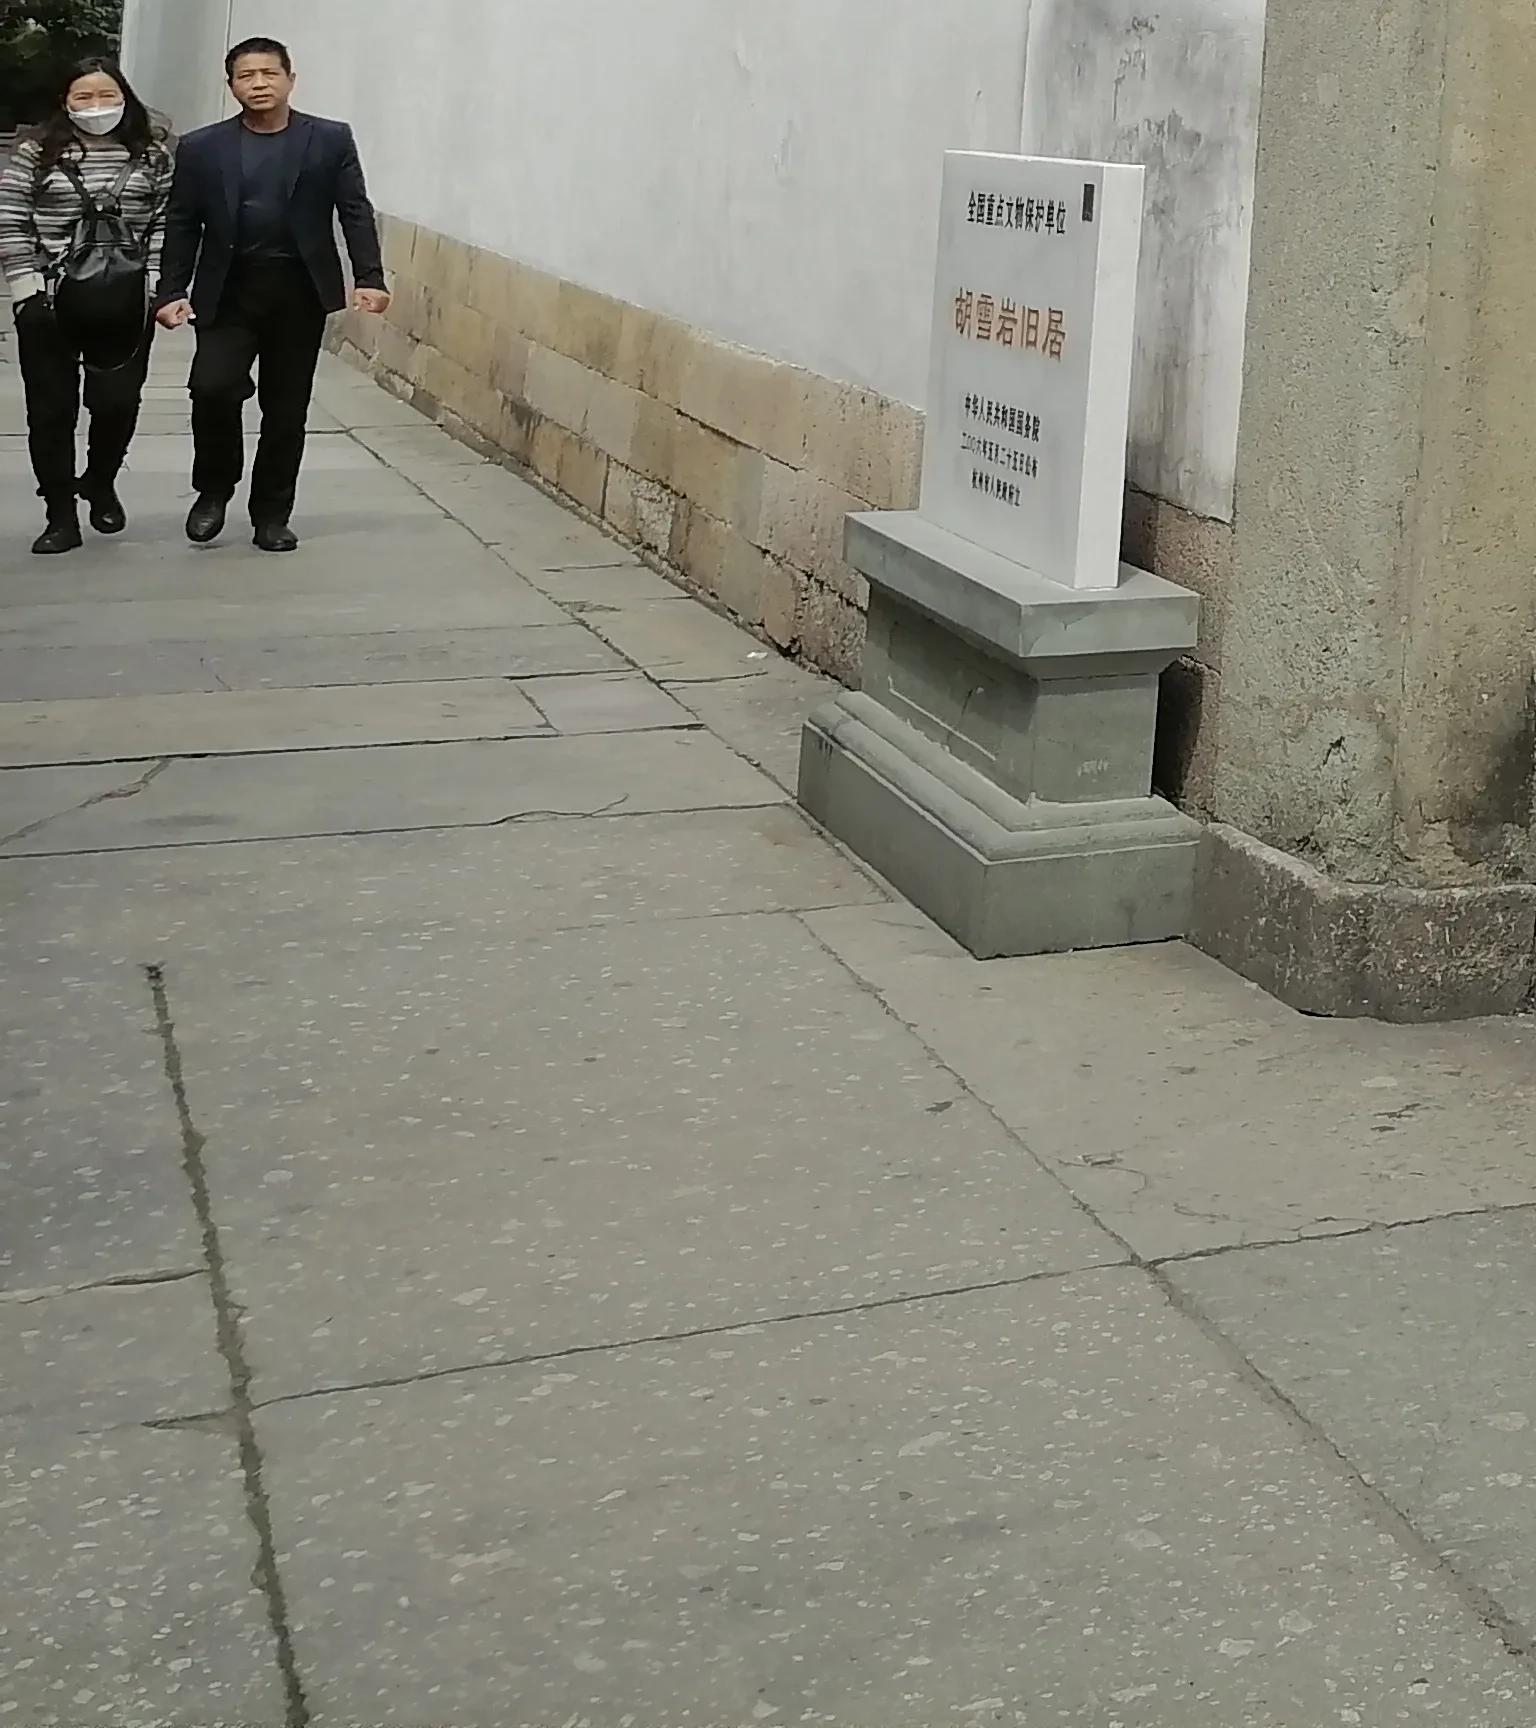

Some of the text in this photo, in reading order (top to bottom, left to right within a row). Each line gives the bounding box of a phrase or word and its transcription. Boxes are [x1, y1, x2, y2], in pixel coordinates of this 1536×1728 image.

[966, 190, 1066, 235] 全国重点文物保护单位
[954, 286, 1066, 362] 胡雪岩旧居
[965, 392, 1040, 442] 中华人民共和国国务院
